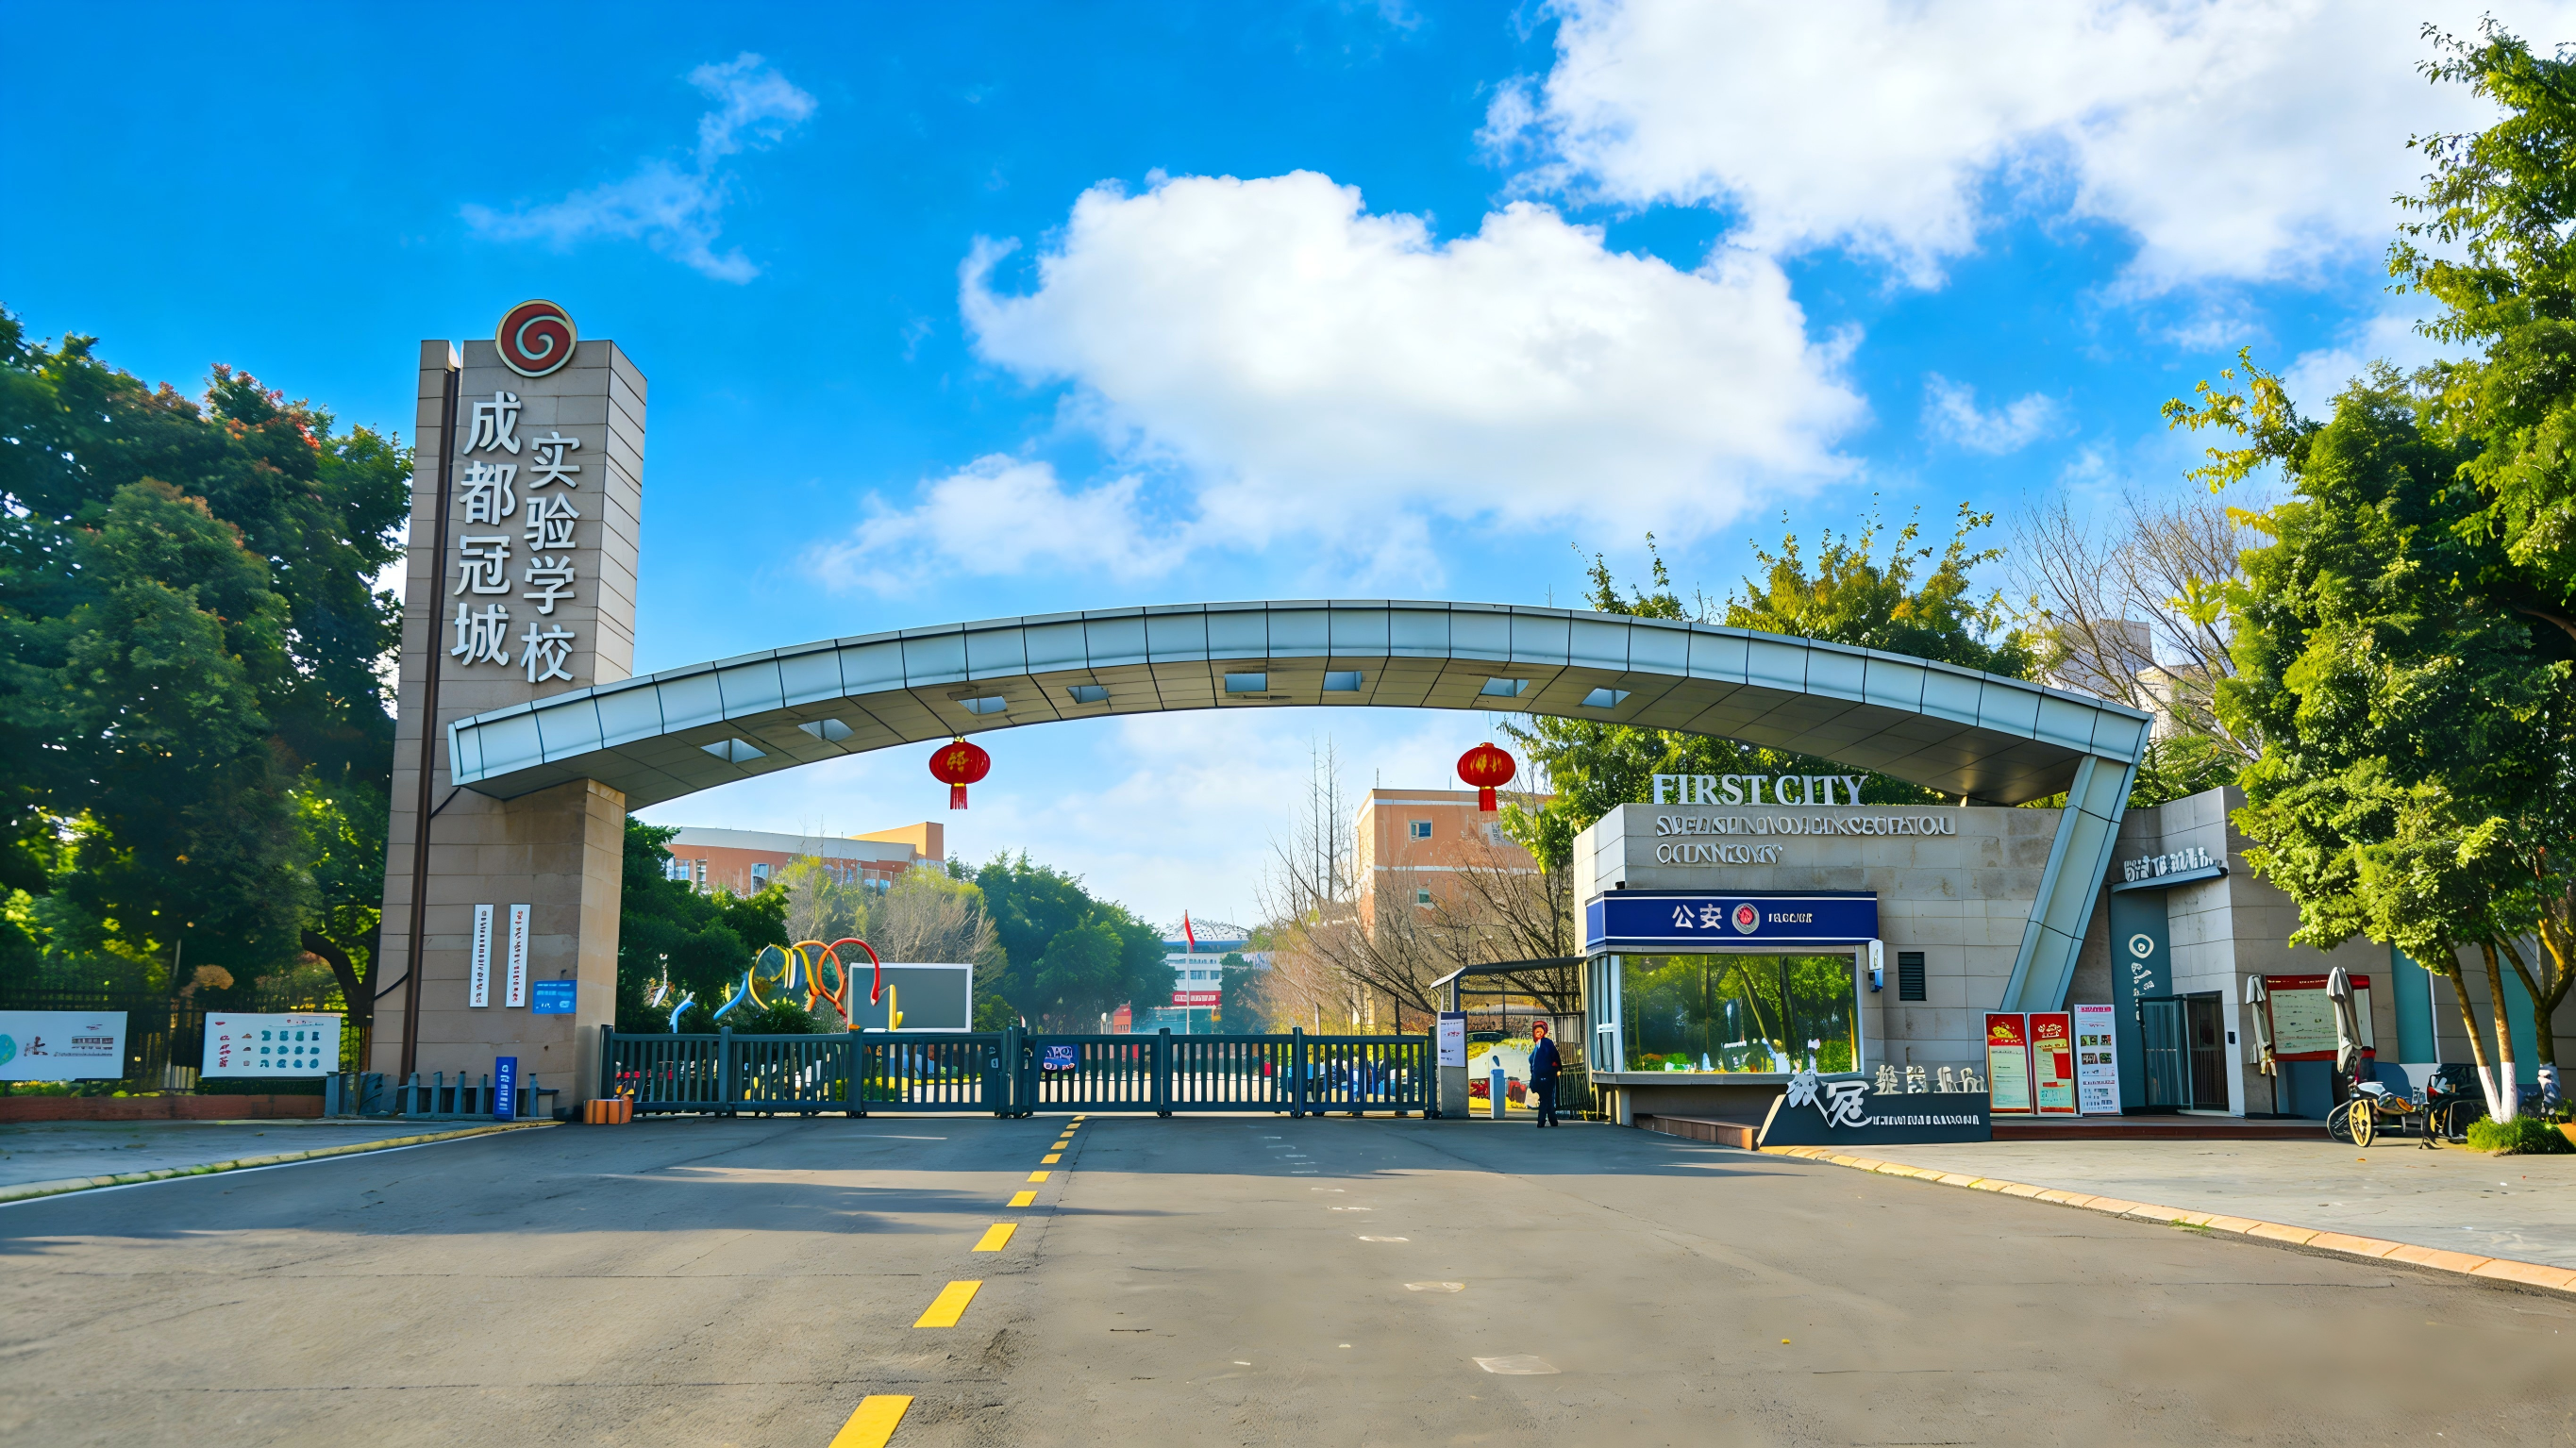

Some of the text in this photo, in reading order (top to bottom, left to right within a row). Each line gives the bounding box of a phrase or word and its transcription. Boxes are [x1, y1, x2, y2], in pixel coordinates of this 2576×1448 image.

[451, 391, 522, 667] 成都冠城
[520, 431, 580, 684] 实验学校
[1653, 774, 1868, 807] FIRST CITY
[1672, 903, 1722, 930] 公安
